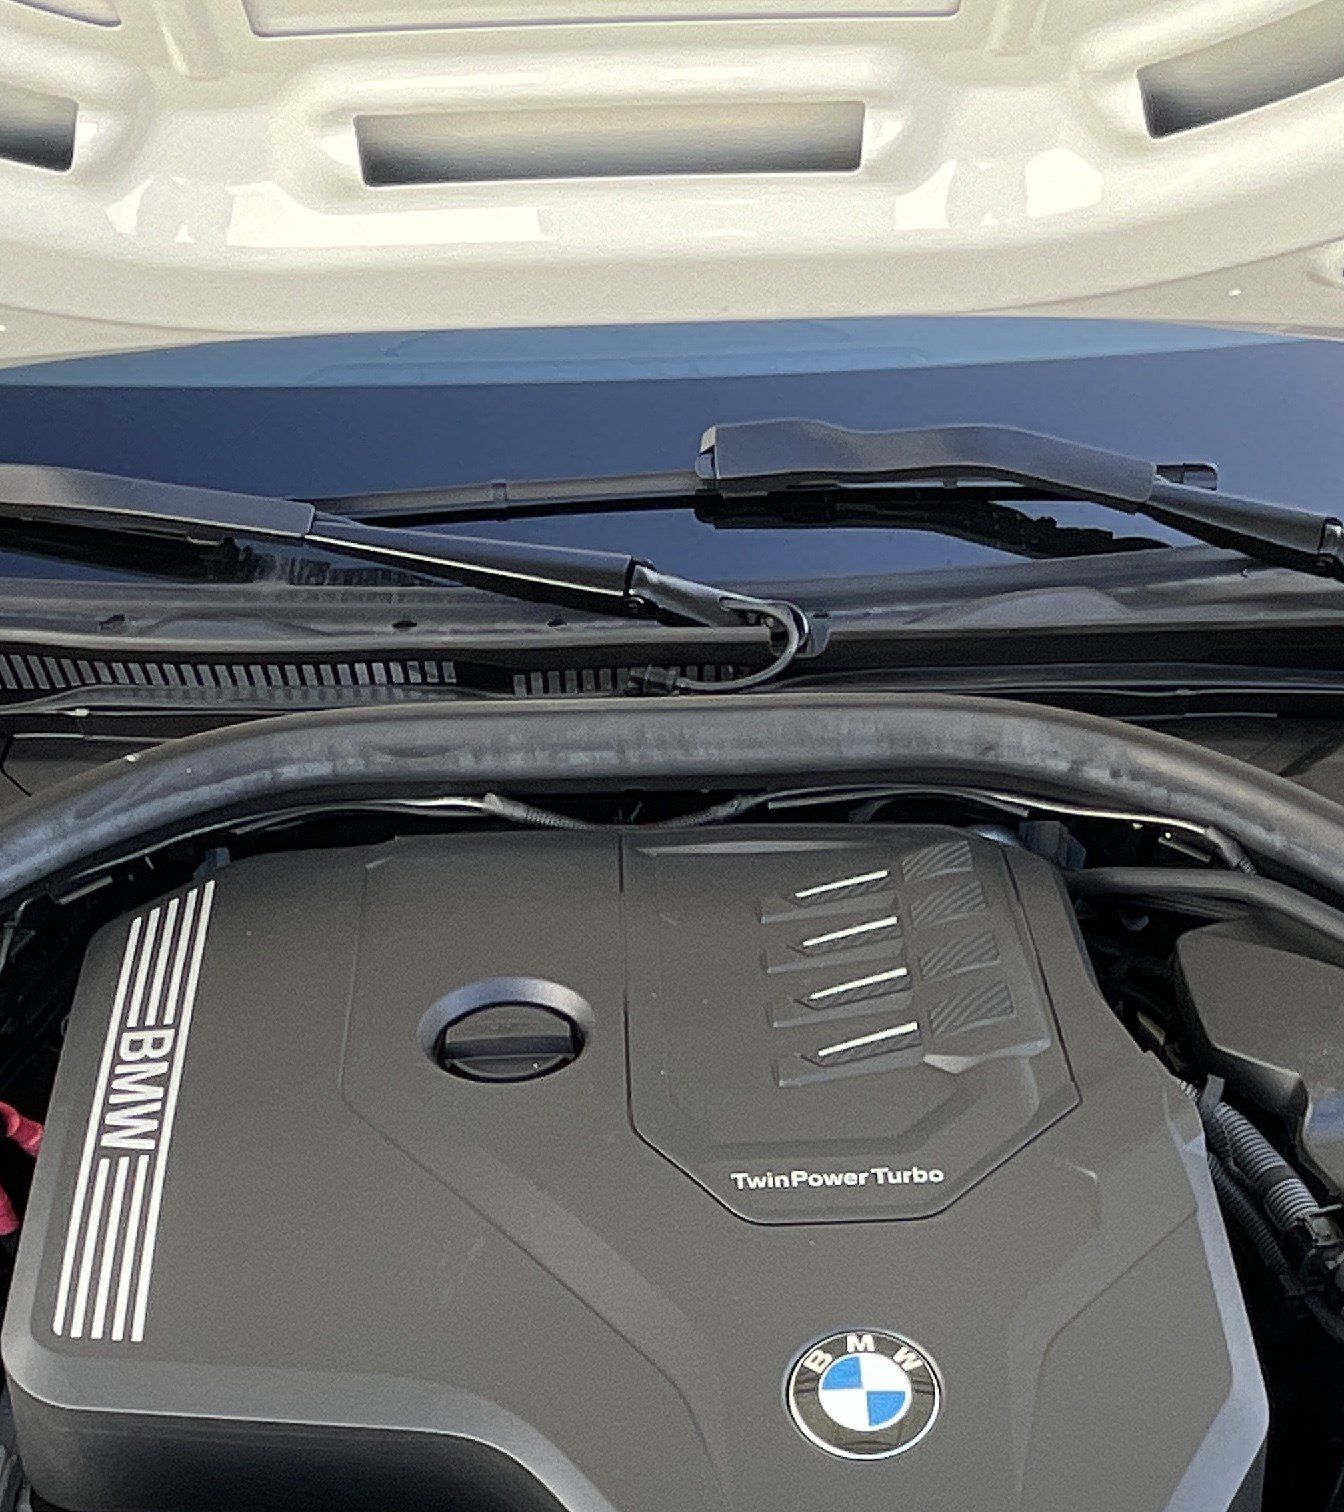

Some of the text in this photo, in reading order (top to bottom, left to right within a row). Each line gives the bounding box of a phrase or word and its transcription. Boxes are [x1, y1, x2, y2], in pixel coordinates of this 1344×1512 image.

[101, 1028, 175, 1150] BMW
[731, 1166, 944, 1190] TwinPower Turbo
[804, 1334, 924, 1374] BMW
